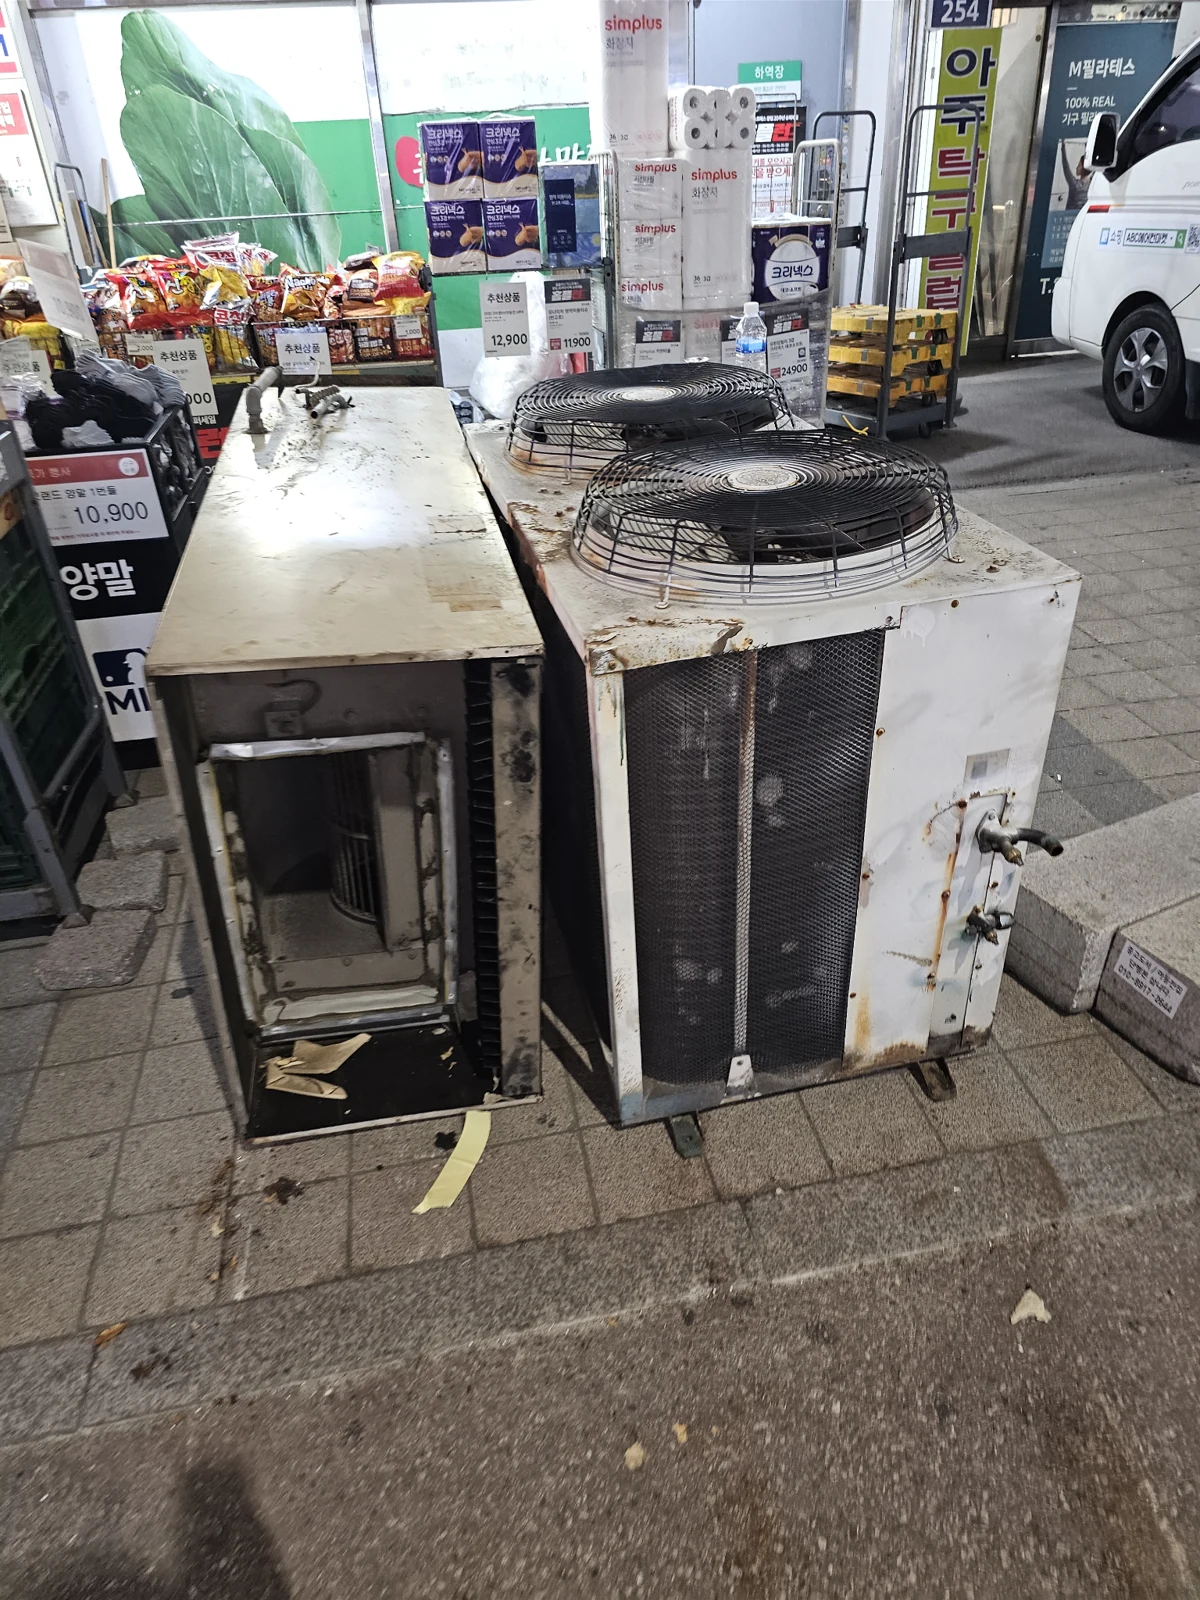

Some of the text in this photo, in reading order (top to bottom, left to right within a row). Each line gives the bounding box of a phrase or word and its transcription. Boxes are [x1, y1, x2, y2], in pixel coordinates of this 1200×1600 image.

[941, 0, 979, 23] 254
[605, 14, 662, 34] simplus
[754, 64, 785, 80] 하역장
[1068, 57, 1136, 80] M필라테스
[1065, 95, 1116, 109] 100% REAL
[1062, 111, 1079, 126] 기구
[427, 128, 463, 140] 크리넥스
[485, 127, 521, 138] 크리넥스
[634, 163, 677, 174] simplus
[691, 168, 738, 183] simplus
[692, 186, 718, 199] 화장지
[430, 205, 466, 216] 크리넥스
[486, 204, 521, 215] 크리넥스
[635, 224, 676, 235] simplus
[771, 265, 813, 279] 크리넥스
[621, 281, 664, 293] simplus
[486, 292, 521, 304] 추천상품
[491, 333, 528, 347] 12,900
[563, 336, 591, 348] 11,900
[284, 342, 321, 354] 추천상품
[160, 350, 197, 361] 추천상품
[781, 363, 808, 377] 24,900
[65, 488, 86, 499] 양말
[74, 501, 148, 524] 10,900
[60, 559, 137, 601] 양말
